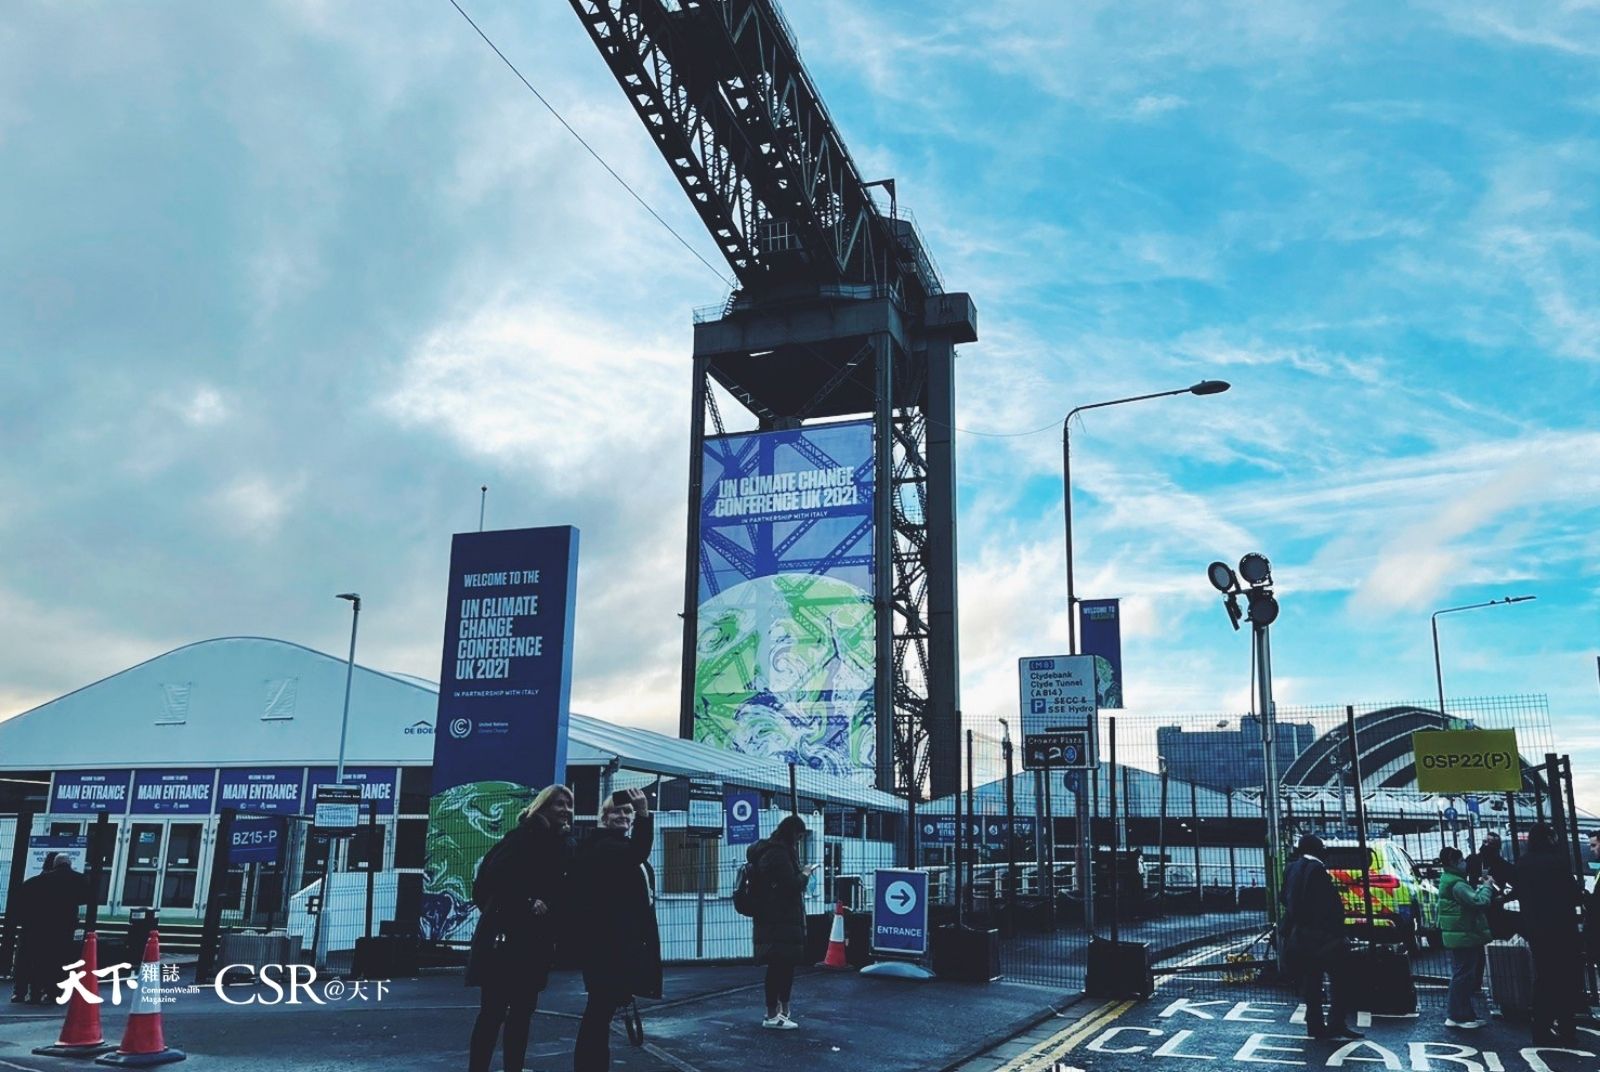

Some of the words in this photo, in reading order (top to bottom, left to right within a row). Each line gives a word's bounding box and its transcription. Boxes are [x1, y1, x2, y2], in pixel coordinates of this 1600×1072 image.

[719, 478, 737, 498] UN
[740, 472, 798, 497] CLIMATE
[799, 466, 856, 491] CHANGE
[714, 490, 799, 517] CONFERENCE
[802, 491, 822, 510] UK
[823, 486, 859, 507] 2021
[749, 514, 792, 523] PARTNERSHIP
[794, 512, 809, 520] WITH
[464, 572, 507, 587] WELCOME
[509, 571, 520, 585] TO
[523, 570, 540, 584] THE
[461, 599, 479, 618] UN
[482, 595, 538, 618] CLIMATE
[459, 617, 514, 639] CHANGE
[457, 636, 543, 659] CONFERENCE
[456, 660, 474, 680] UK
[476, 658, 509, 679] 2021
[1030, 671, 1073, 680] Clydebank
[1030, 681, 1053, 689] Clyde
[1034, 700, 1044, 712] P
[1068, 705, 1094, 714] Hydro
[404, 727, 415, 735] DE
[417, 727, 434, 735] BOE
[1423, 752, 1512, 770] OSP22(P)
[57, 785, 80, 799] MAIN
[81, 785, 126, 800] ENTRANCE
[137, 784, 162, 799] MAIN
[162, 784, 210, 800] ENTRANCE
[222, 784, 249, 799] MAIN
[249, 783, 298, 800] ENTRANCE
[233, 830, 278, 846] BZ15-P
[877, 925, 922, 938] ENTRANCE
[1086, 1026, 1484, 1072] CLEAR
